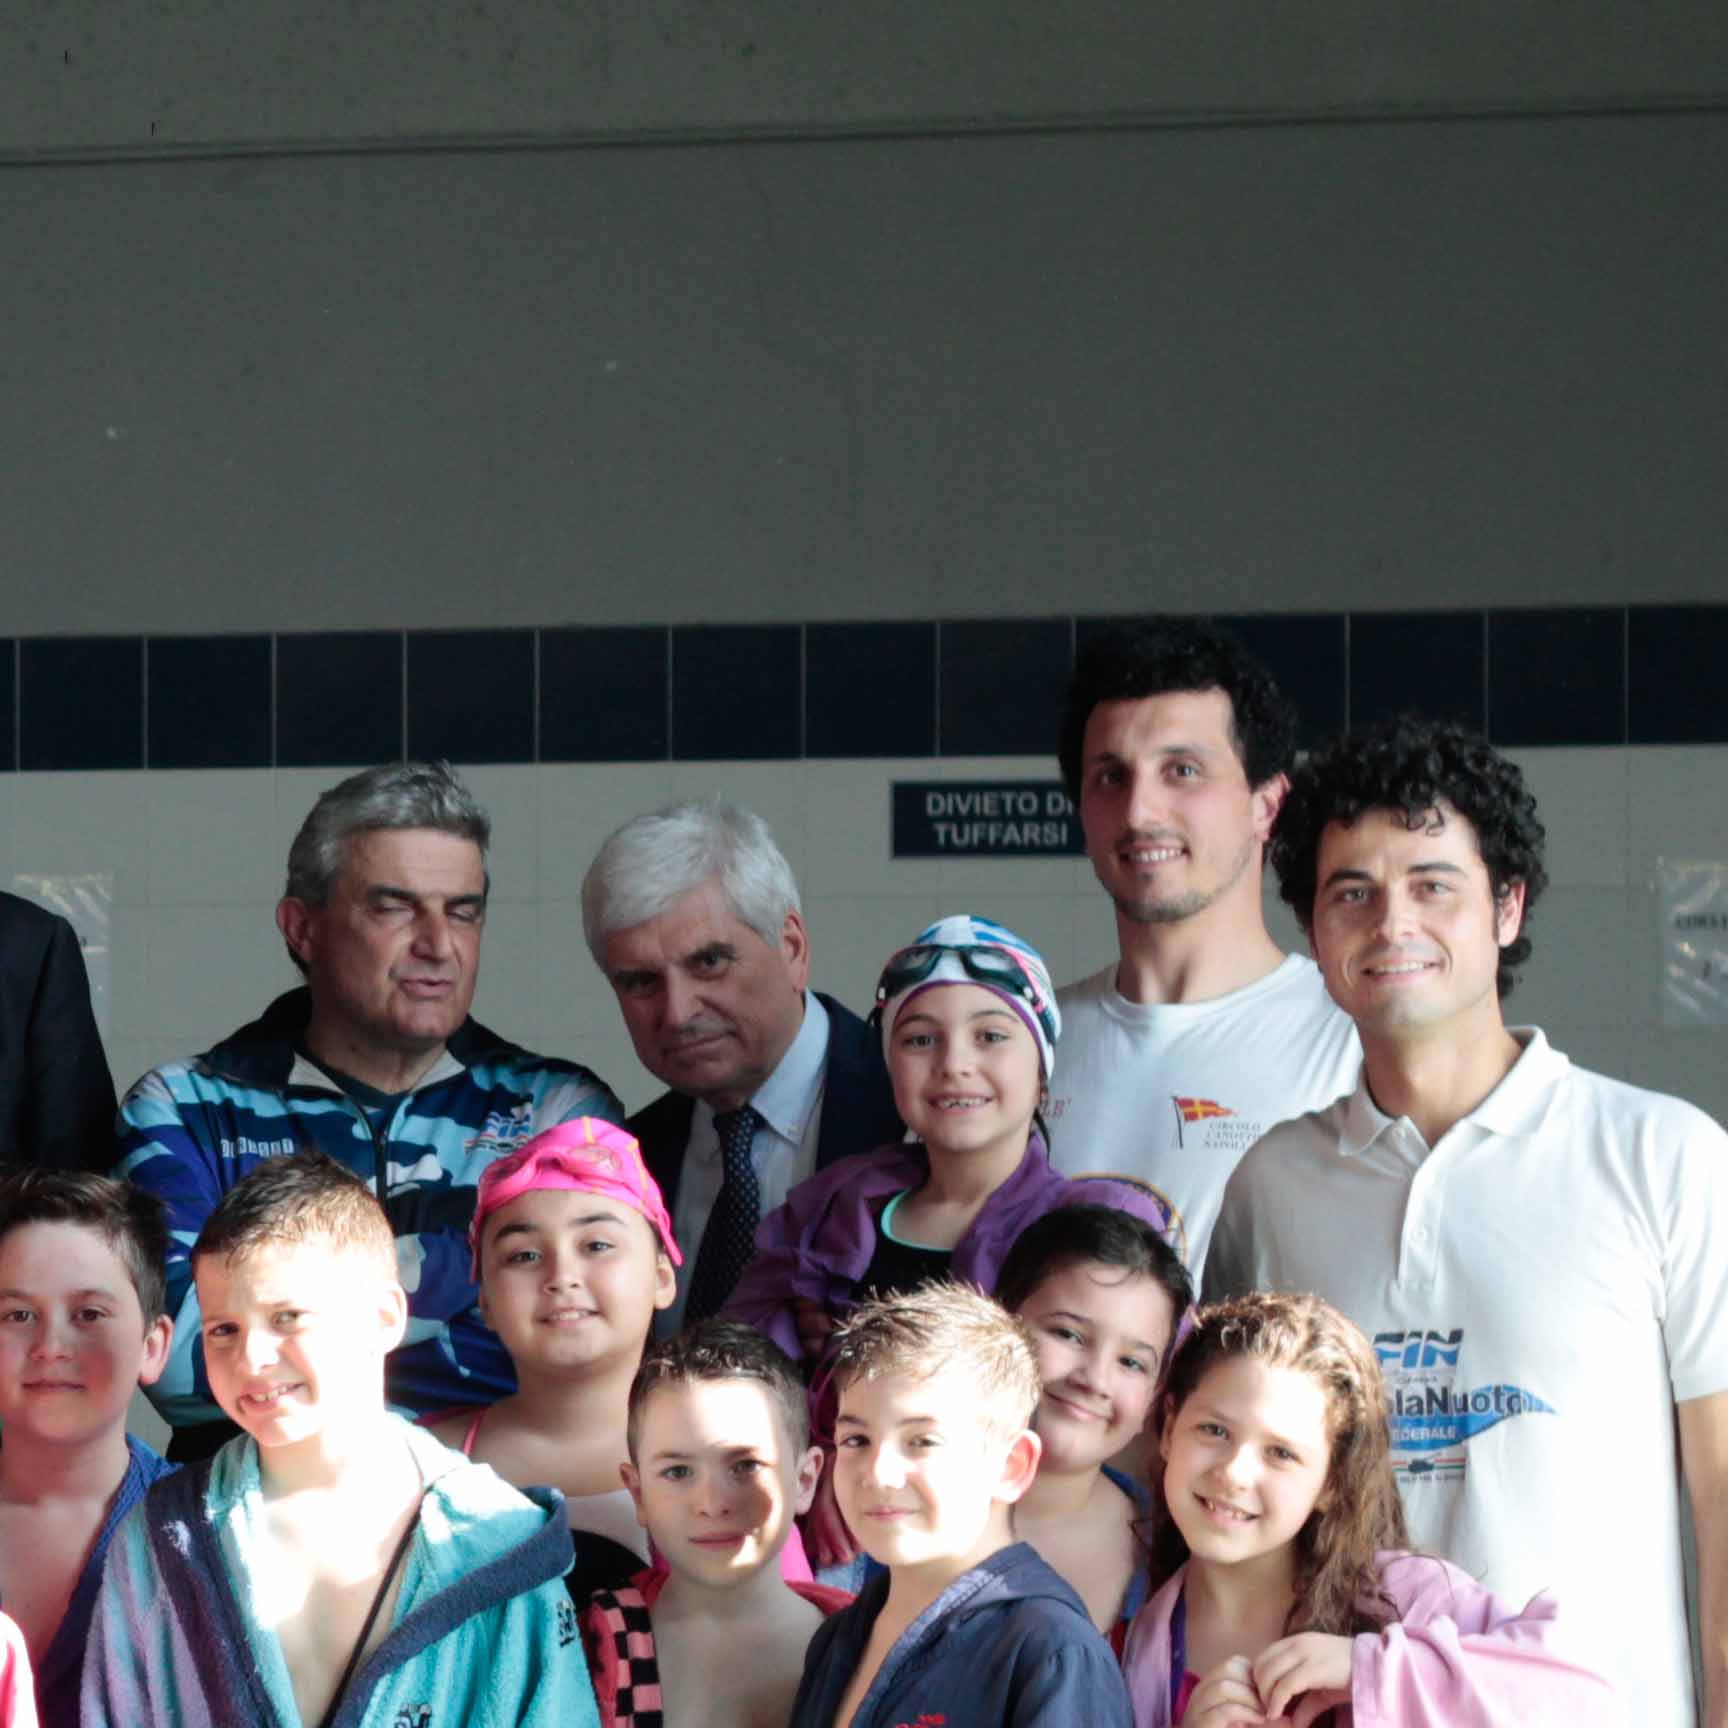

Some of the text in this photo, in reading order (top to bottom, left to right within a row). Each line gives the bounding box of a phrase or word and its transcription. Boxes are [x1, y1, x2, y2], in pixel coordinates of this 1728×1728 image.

[925, 791, 1039, 816] DIVIETO
[932, 821, 1068, 847] TUFFARSI
[1373, 1329, 1464, 1368] FIN
